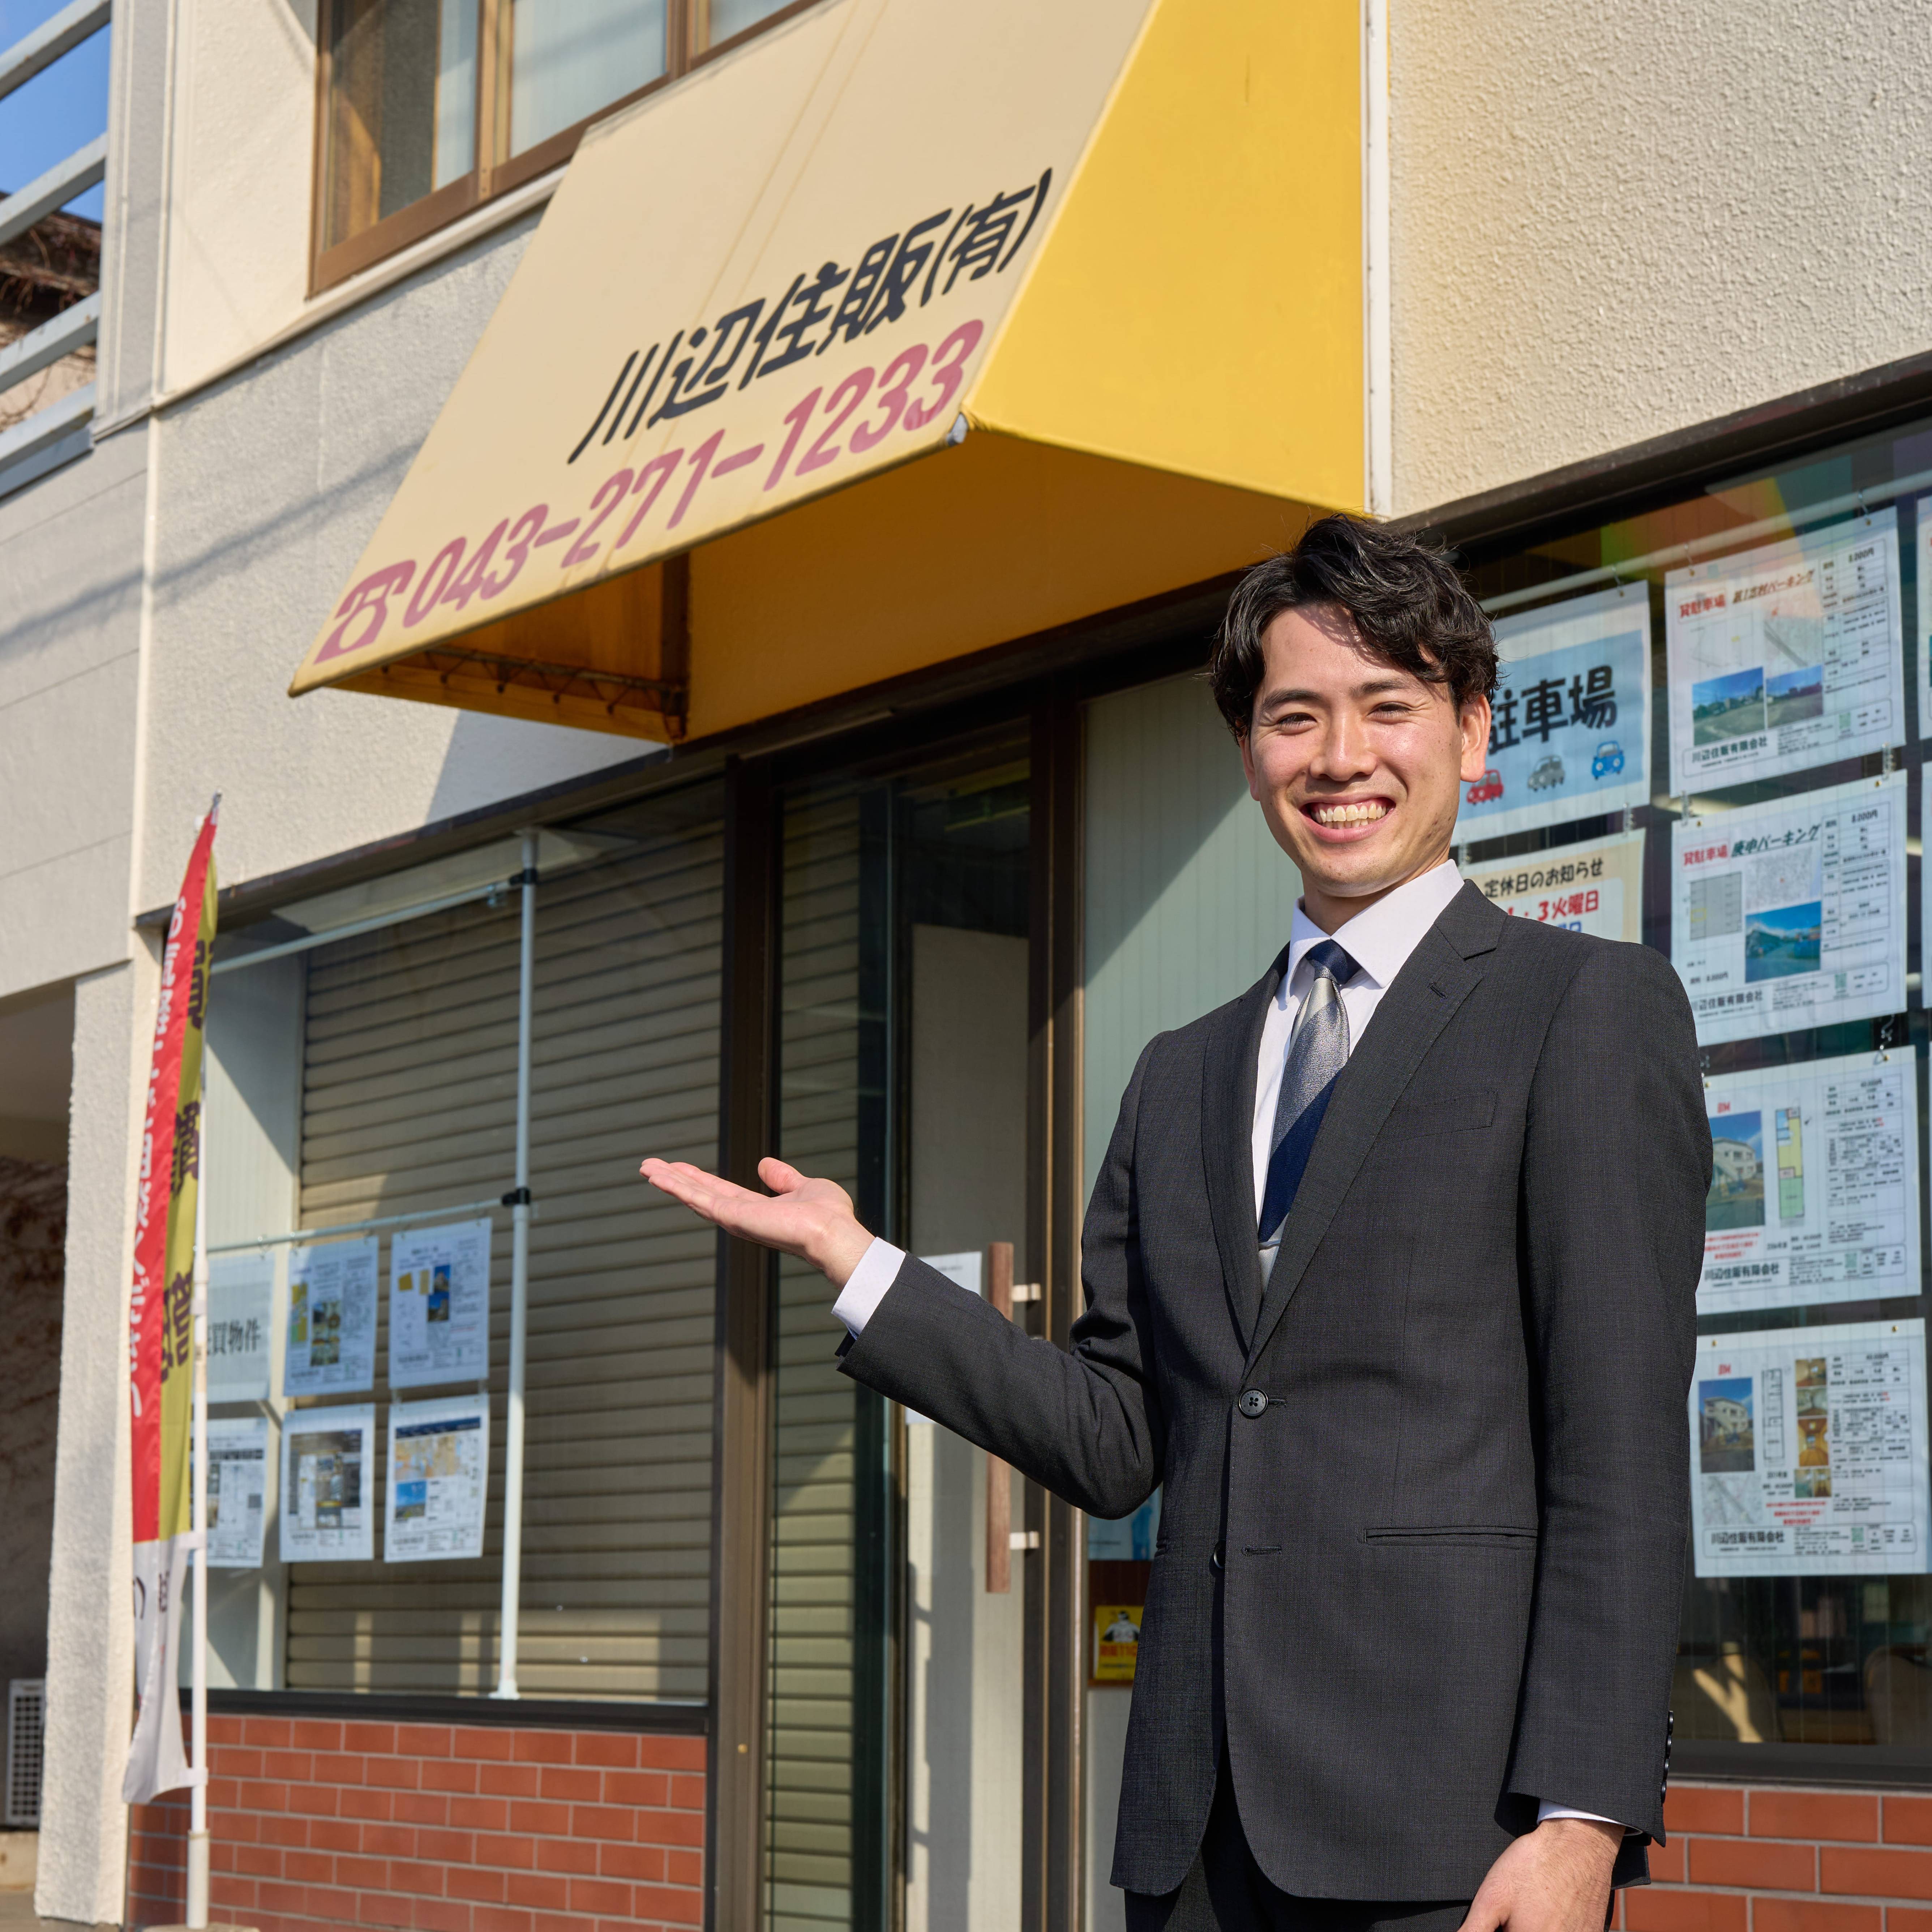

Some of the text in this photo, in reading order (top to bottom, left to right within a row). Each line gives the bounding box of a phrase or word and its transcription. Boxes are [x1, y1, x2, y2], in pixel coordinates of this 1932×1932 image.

[567, 167, 1053, 465] 川辺住販(有)
[402, 319, 984, 629] 043-271-1233
[1484, 857, 1604, 898] 定休日のお知らせ
